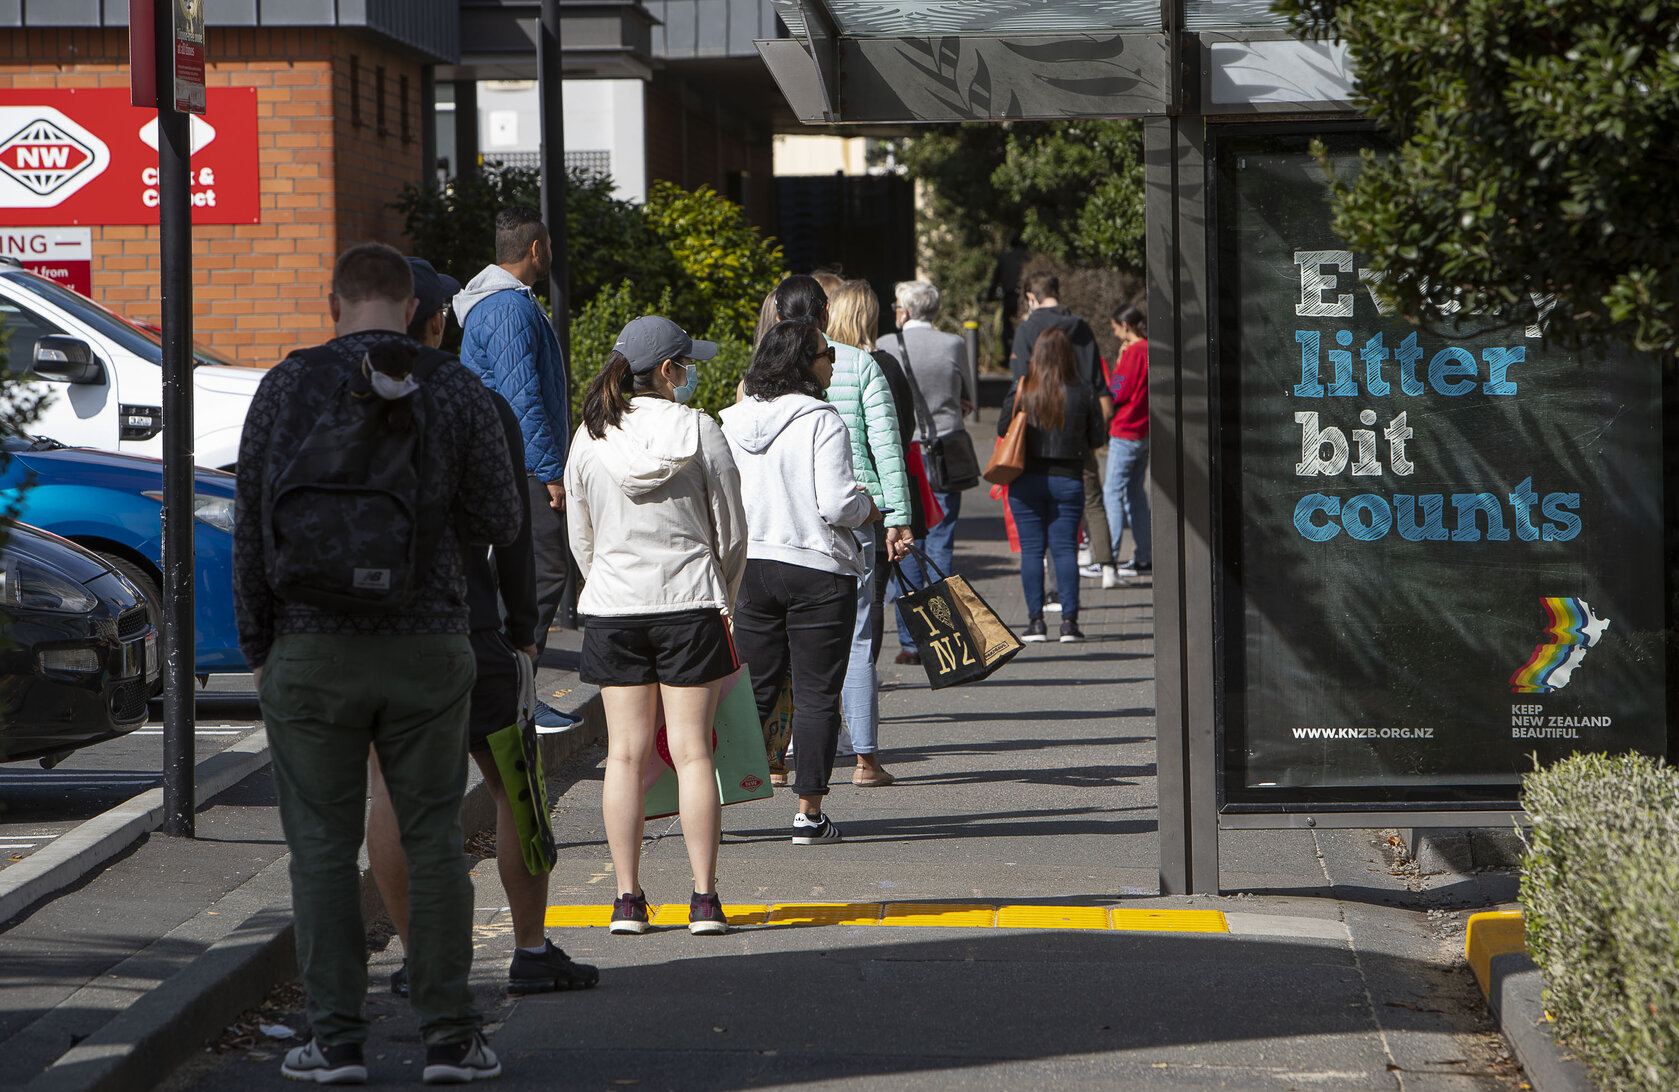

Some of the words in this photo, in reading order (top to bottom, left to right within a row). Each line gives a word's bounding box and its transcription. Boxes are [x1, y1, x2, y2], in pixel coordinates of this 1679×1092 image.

[16, 146, 70, 168] NW
[41, 265, 69, 278] from
[1293, 329, 1526, 398] litter
[1294, 409, 1415, 477] bit
[1292, 476, 1583, 543] counts
[1511, 704, 1544, 715] KEEP
[1511, 715, 1545, 727] NEW
[1547, 716, 1613, 727] ZEALAND
[1291, 727, 1435, 739] WWW.KNZB.ORG.NZ
[1511, 728, 1580, 739] BEAUTIFUL
